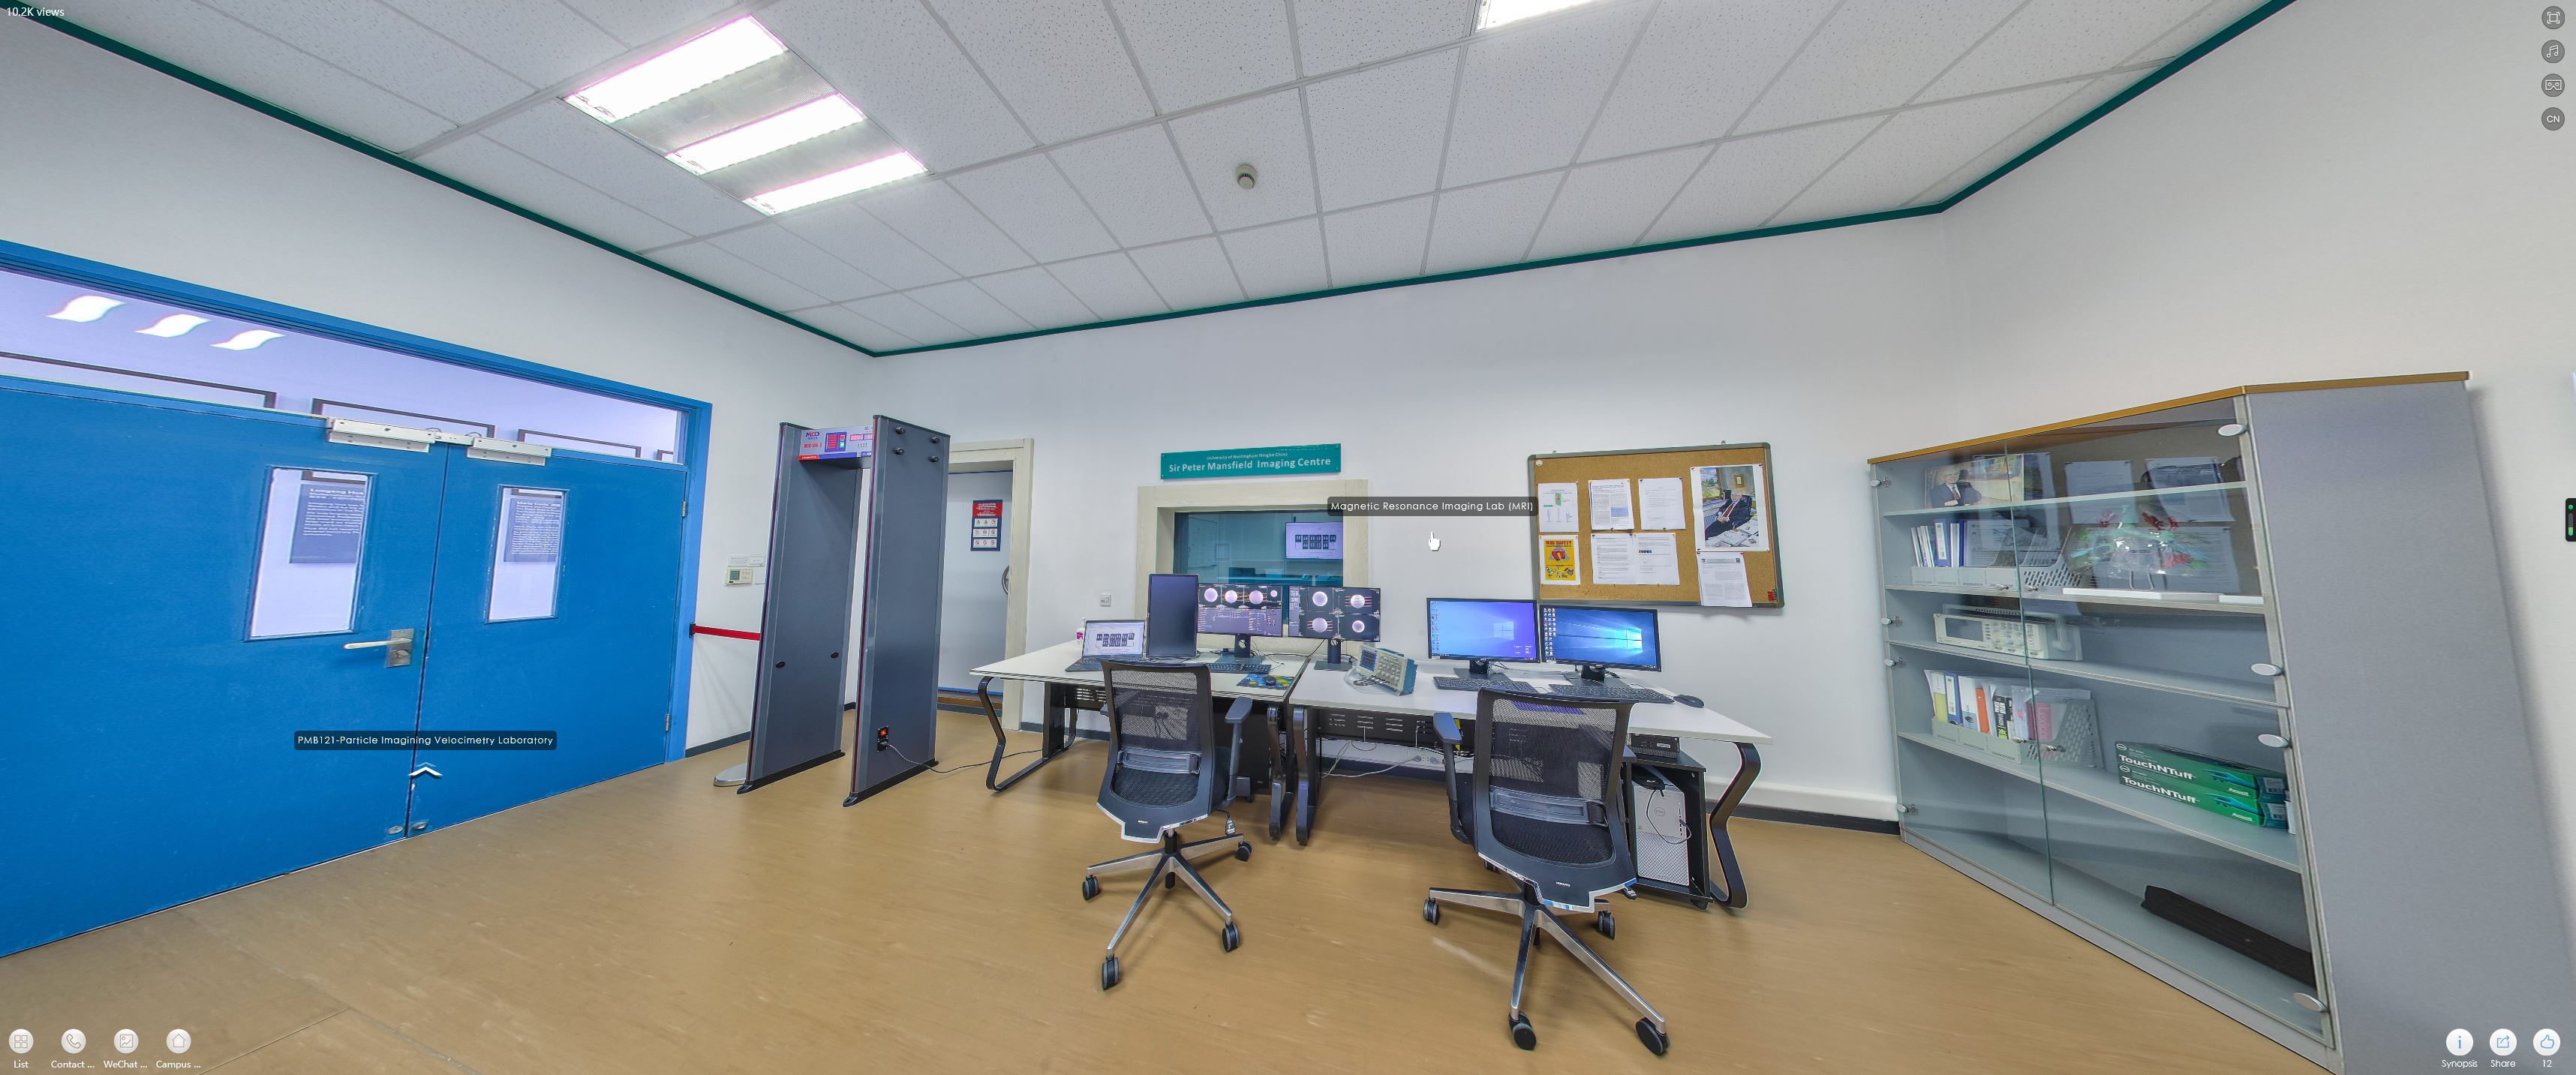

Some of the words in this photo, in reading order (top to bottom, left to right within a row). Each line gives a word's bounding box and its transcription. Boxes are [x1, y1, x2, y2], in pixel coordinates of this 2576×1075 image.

[1169, 464, 1180, 473] Sir
[1182, 464, 1205, 472] Peter
[1207, 460, 1252, 470] Mansfield
[1257, 457, 1296, 469] Imaging
[1297, 458, 1331, 467] Centre
[2118, 755, 2193, 780] TouchNTuff
[2121, 776, 2197, 803] TouchNTuff
